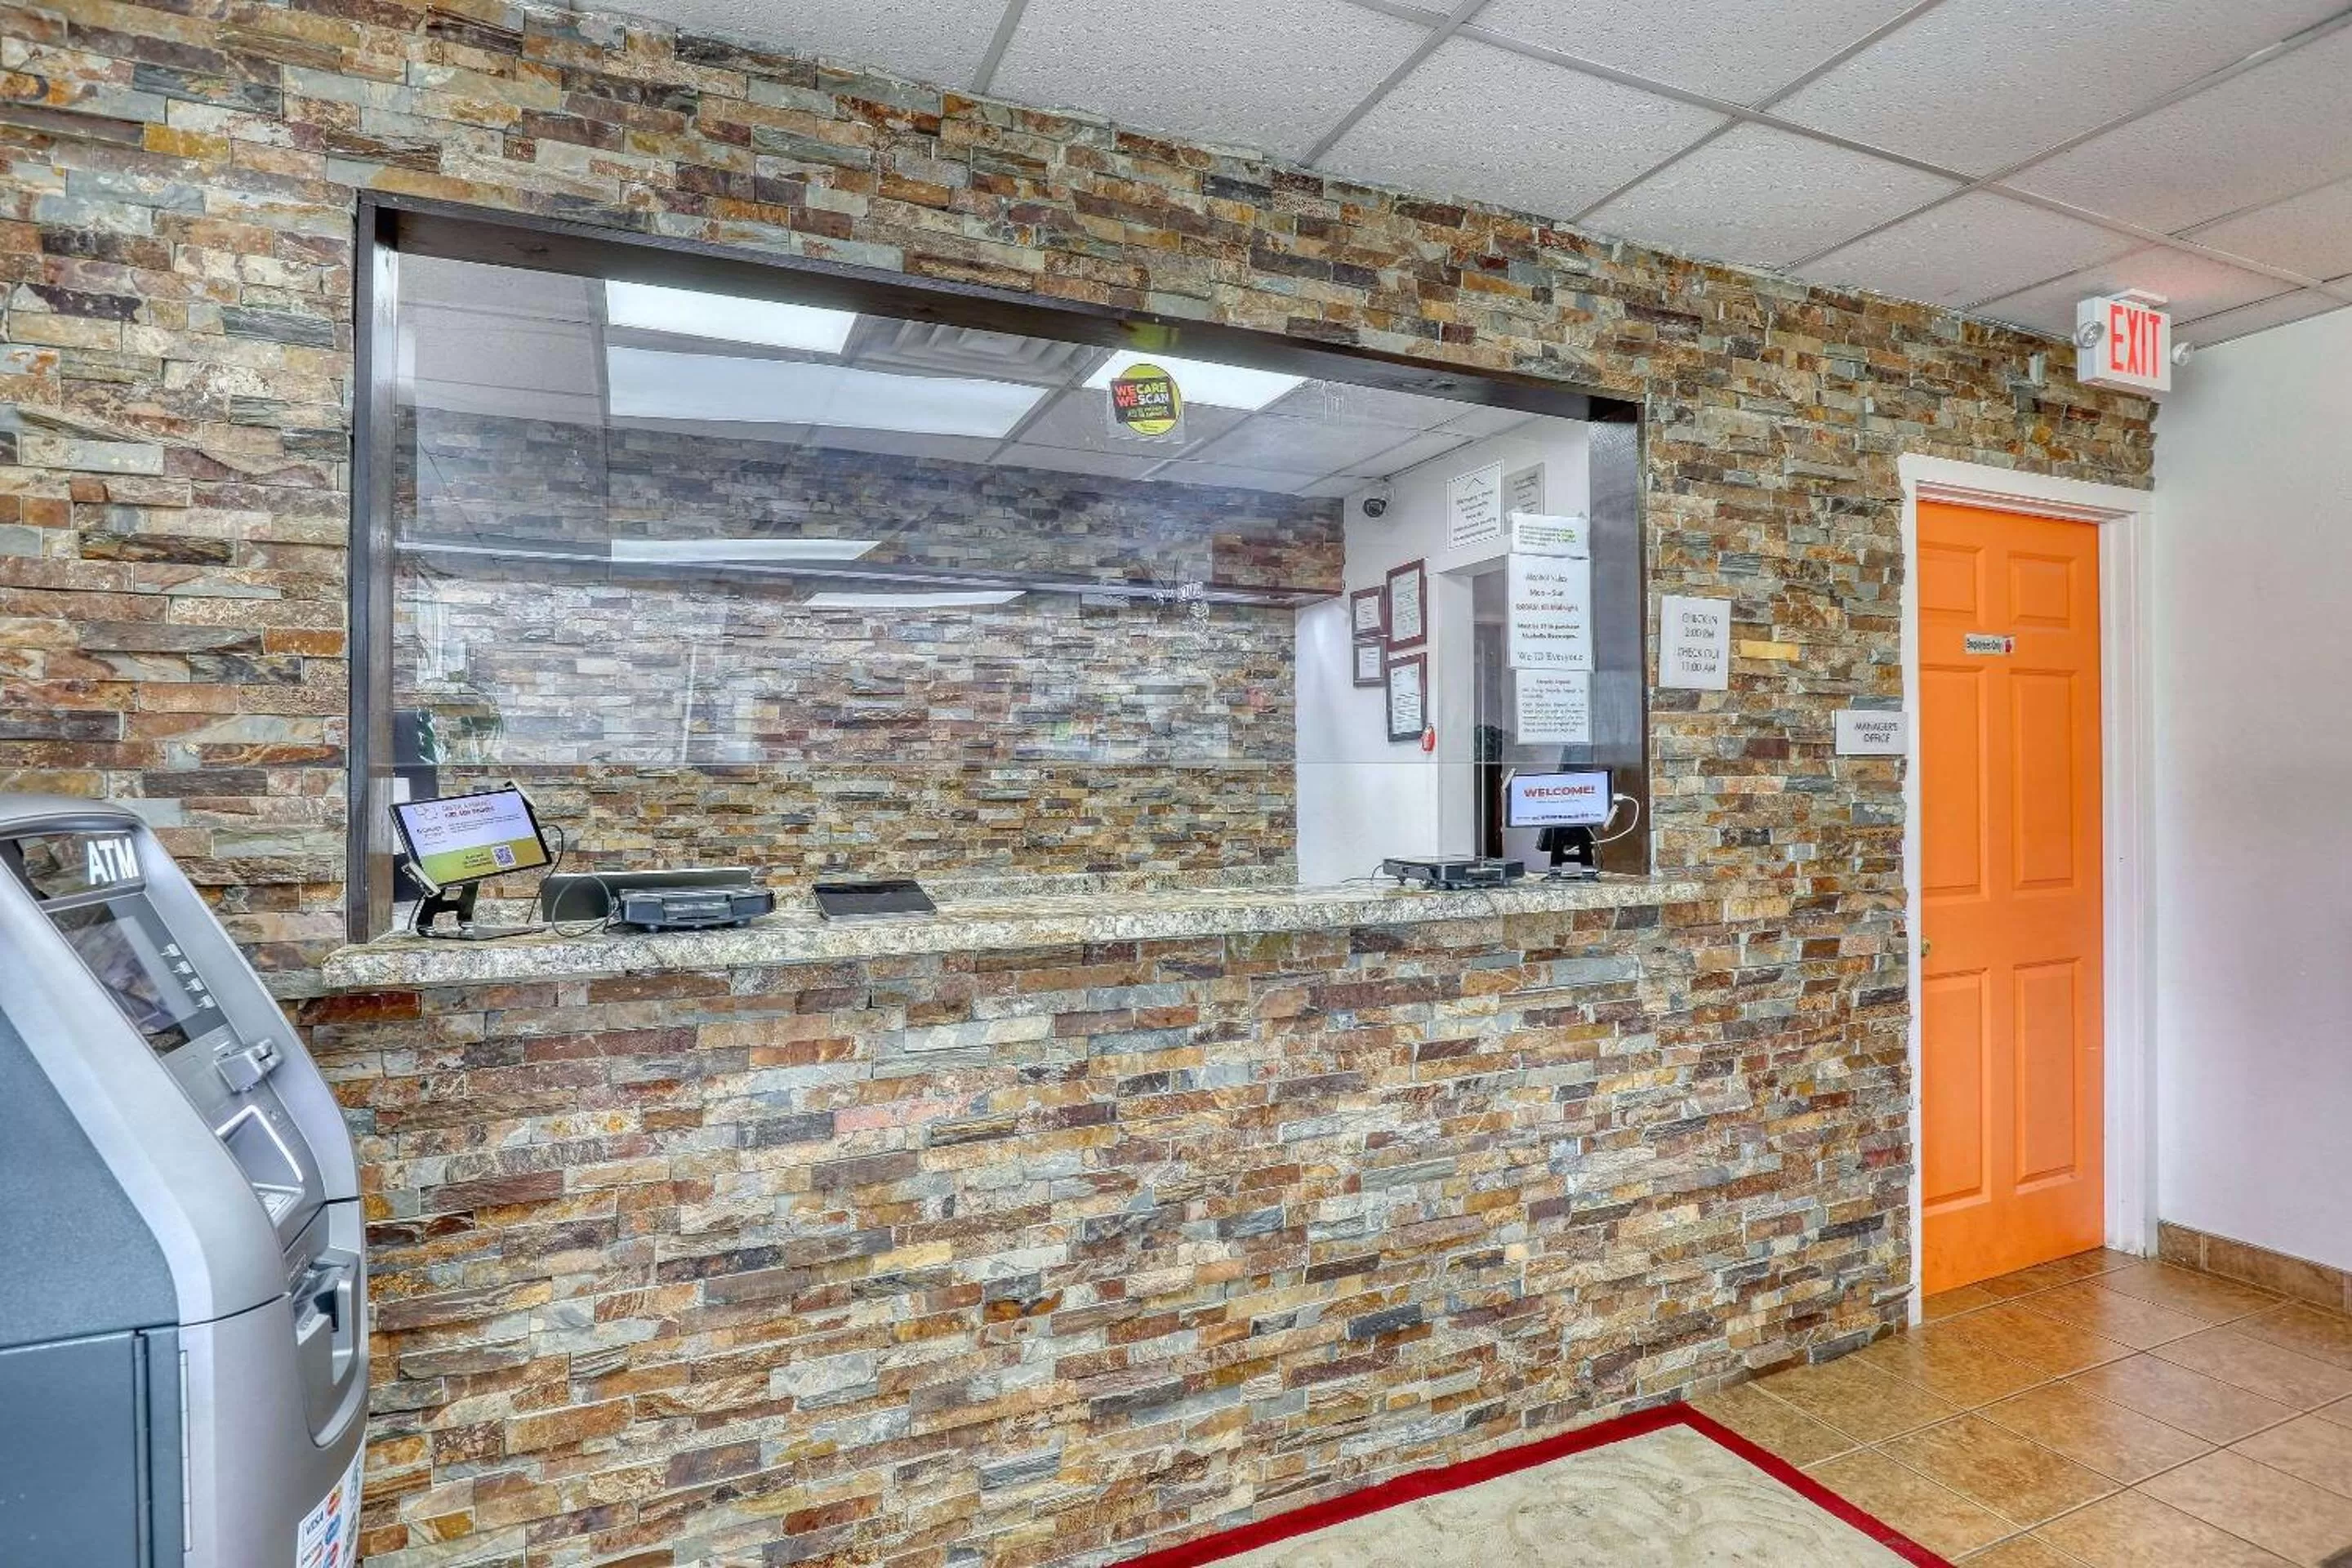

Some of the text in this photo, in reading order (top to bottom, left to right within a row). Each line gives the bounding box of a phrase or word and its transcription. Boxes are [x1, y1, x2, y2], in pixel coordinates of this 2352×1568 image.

[2109, 303, 2161, 378] EXIT
[1114, 381, 1168, 397] WE CARE
[1116, 393, 1169, 407] WE SCAN
[1685, 626, 1715, 639] 2:00 PM
[1704, 663, 1717, 673] AM
[1864, 733, 1891, 743] OFFICE
[1523, 785, 1596, 798] WELCOME!
[87, 837, 140, 885] ATM
